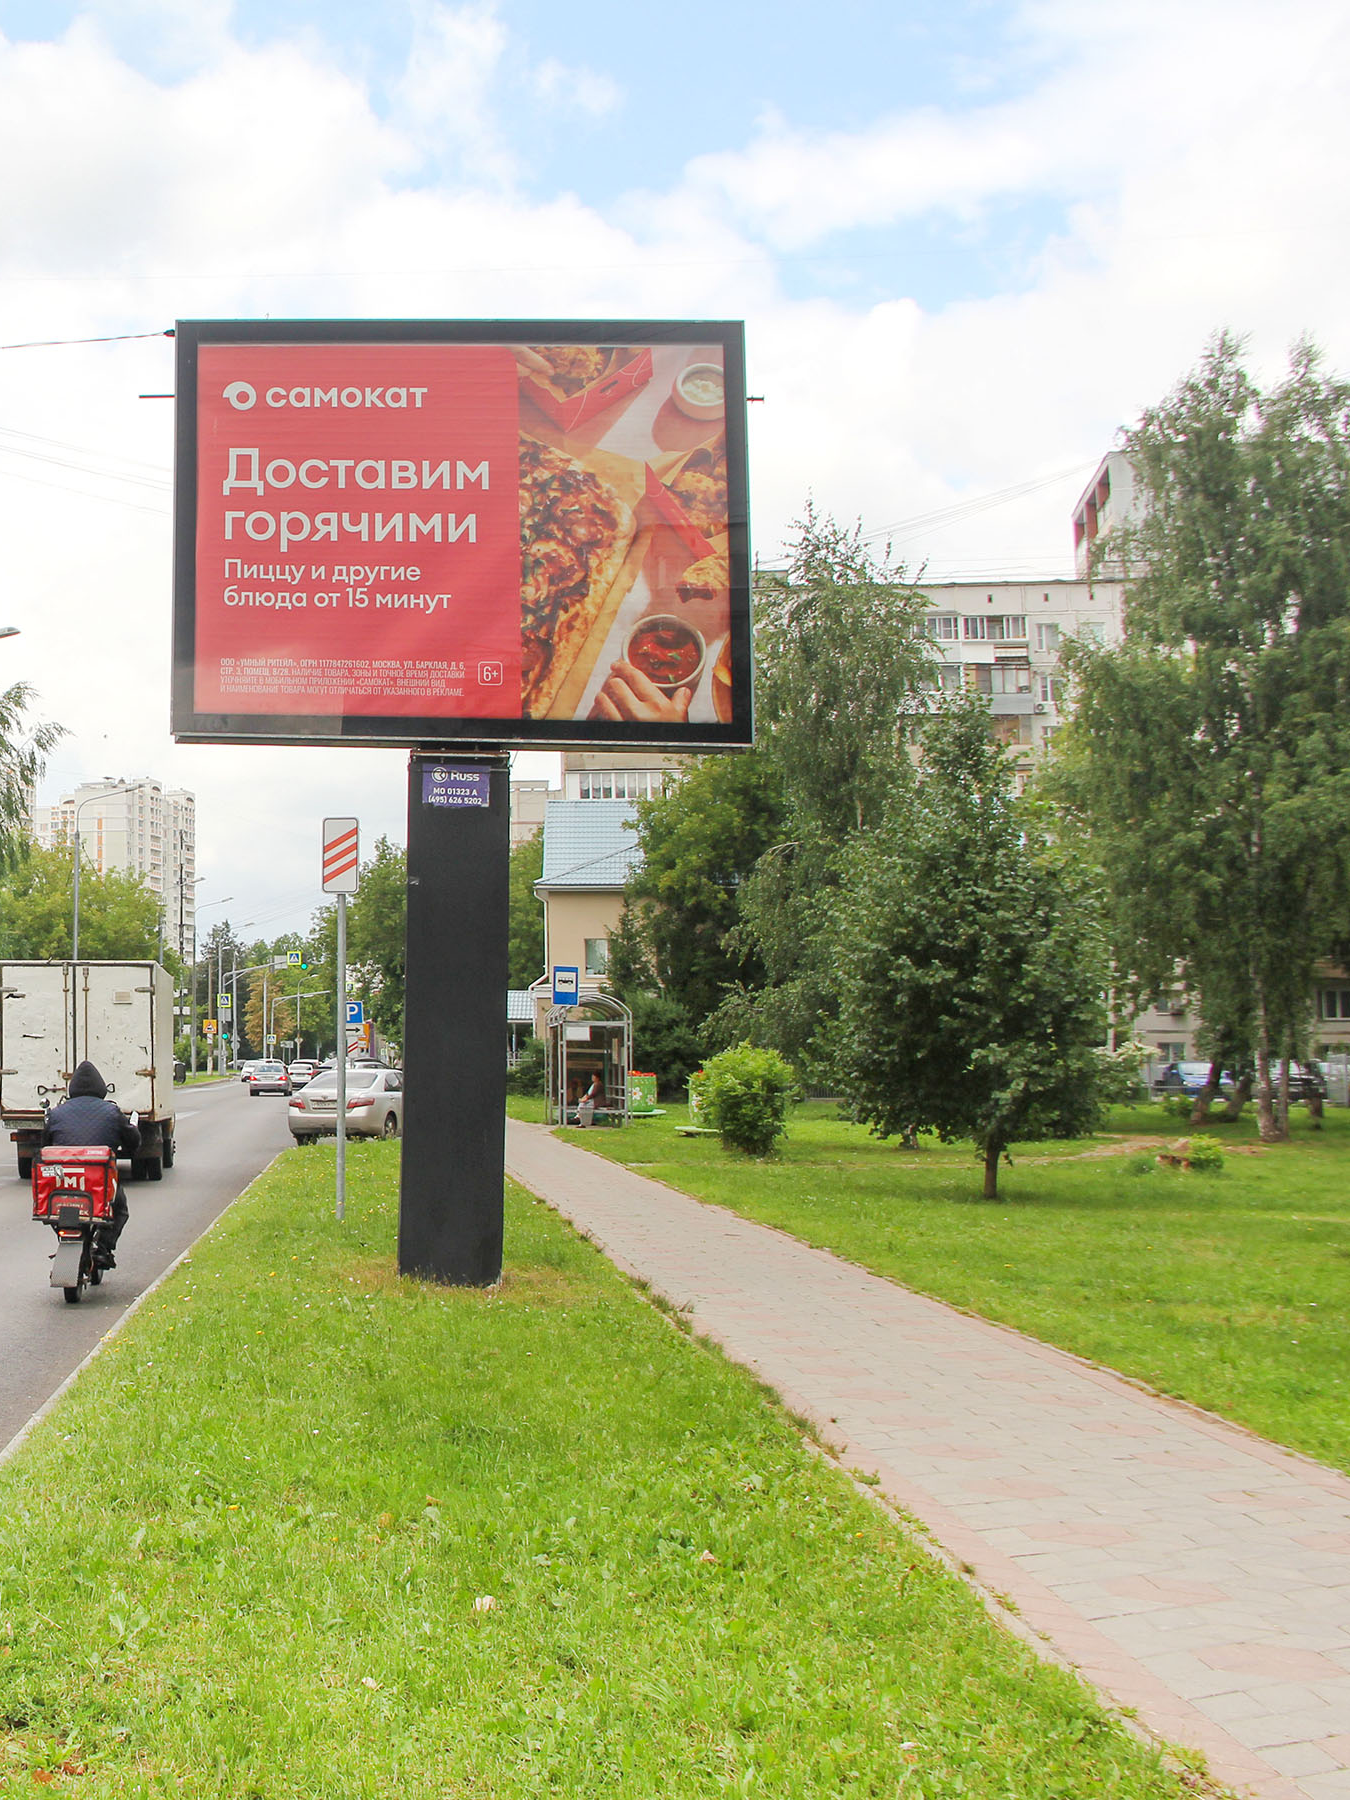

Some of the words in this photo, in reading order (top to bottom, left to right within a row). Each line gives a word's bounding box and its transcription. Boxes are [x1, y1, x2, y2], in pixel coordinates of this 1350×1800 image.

[265, 386, 428, 408] самокат
[222, 447, 490, 496] Доставим
[224, 511, 477, 552] горячими
[224, 559, 305, 584] Пиццу
[311, 565, 326, 580] и
[331, 565, 421, 586] другие
[223, 585, 307, 610] блюда
[313, 593, 341, 608] от
[345, 587, 368, 608] 15
[375, 593, 452, 614] минут
[220, 657, 235, 666] ООО
[299, 659, 318, 668] ОГРН
[291, 668, 323, 676] НАЛИЧИЕ
[352, 669, 372, 677] ЗОНЫ
[379, 669, 405, 677] ТОЧНОЕ
[405, 670, 429, 678] ВРЕМЯ
[429, 670, 466, 679] ДОСТАВКИ
[482, 666, 499, 682] 6+
[431, 679, 446, 688] ВИД
[307, 686, 328, 695] МОГУТ
[450, 771, 480, 781] Russ
[447, 788, 470, 796] 01323
[428, 795, 447, 804] (495)
[449, 796, 462, 804] 626
[346, 1003, 359, 1022] P
